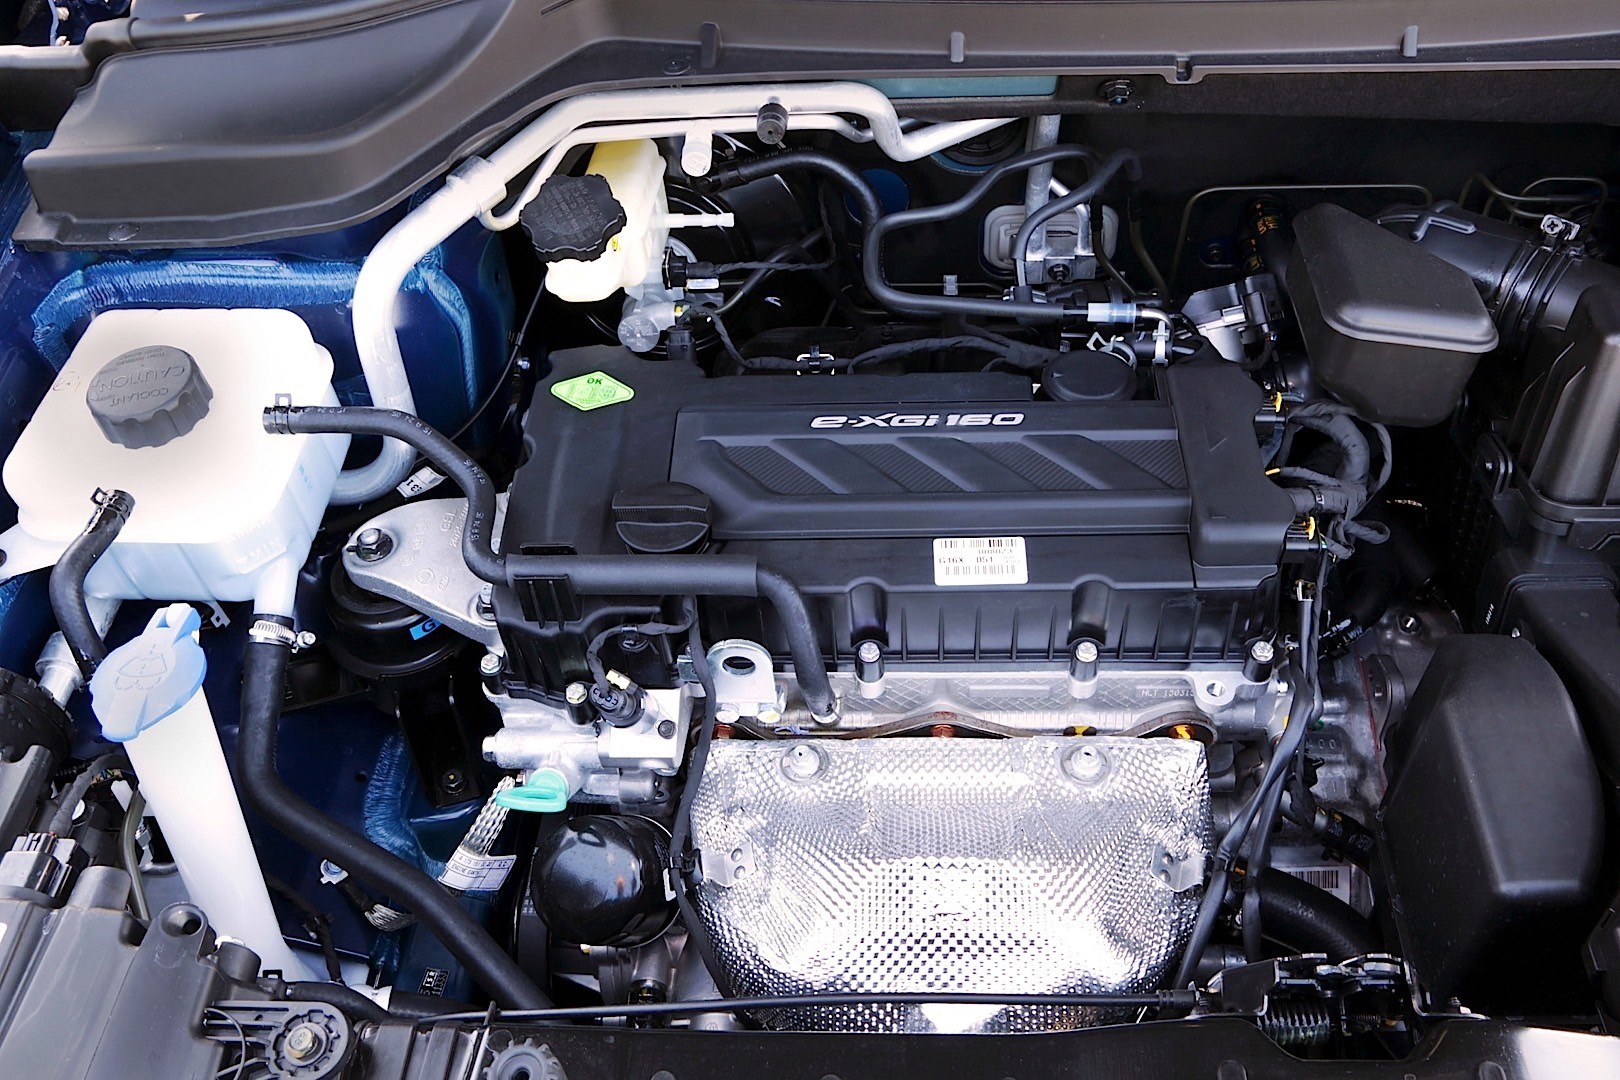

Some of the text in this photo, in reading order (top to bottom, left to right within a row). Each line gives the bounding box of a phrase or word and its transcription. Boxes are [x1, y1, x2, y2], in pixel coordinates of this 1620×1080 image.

[99, 366, 185, 392] CAUTION
[586, 377, 604, 385] OK
[110, 387, 169, 407] COOLANT
[945, 412, 1025, 426] 160
